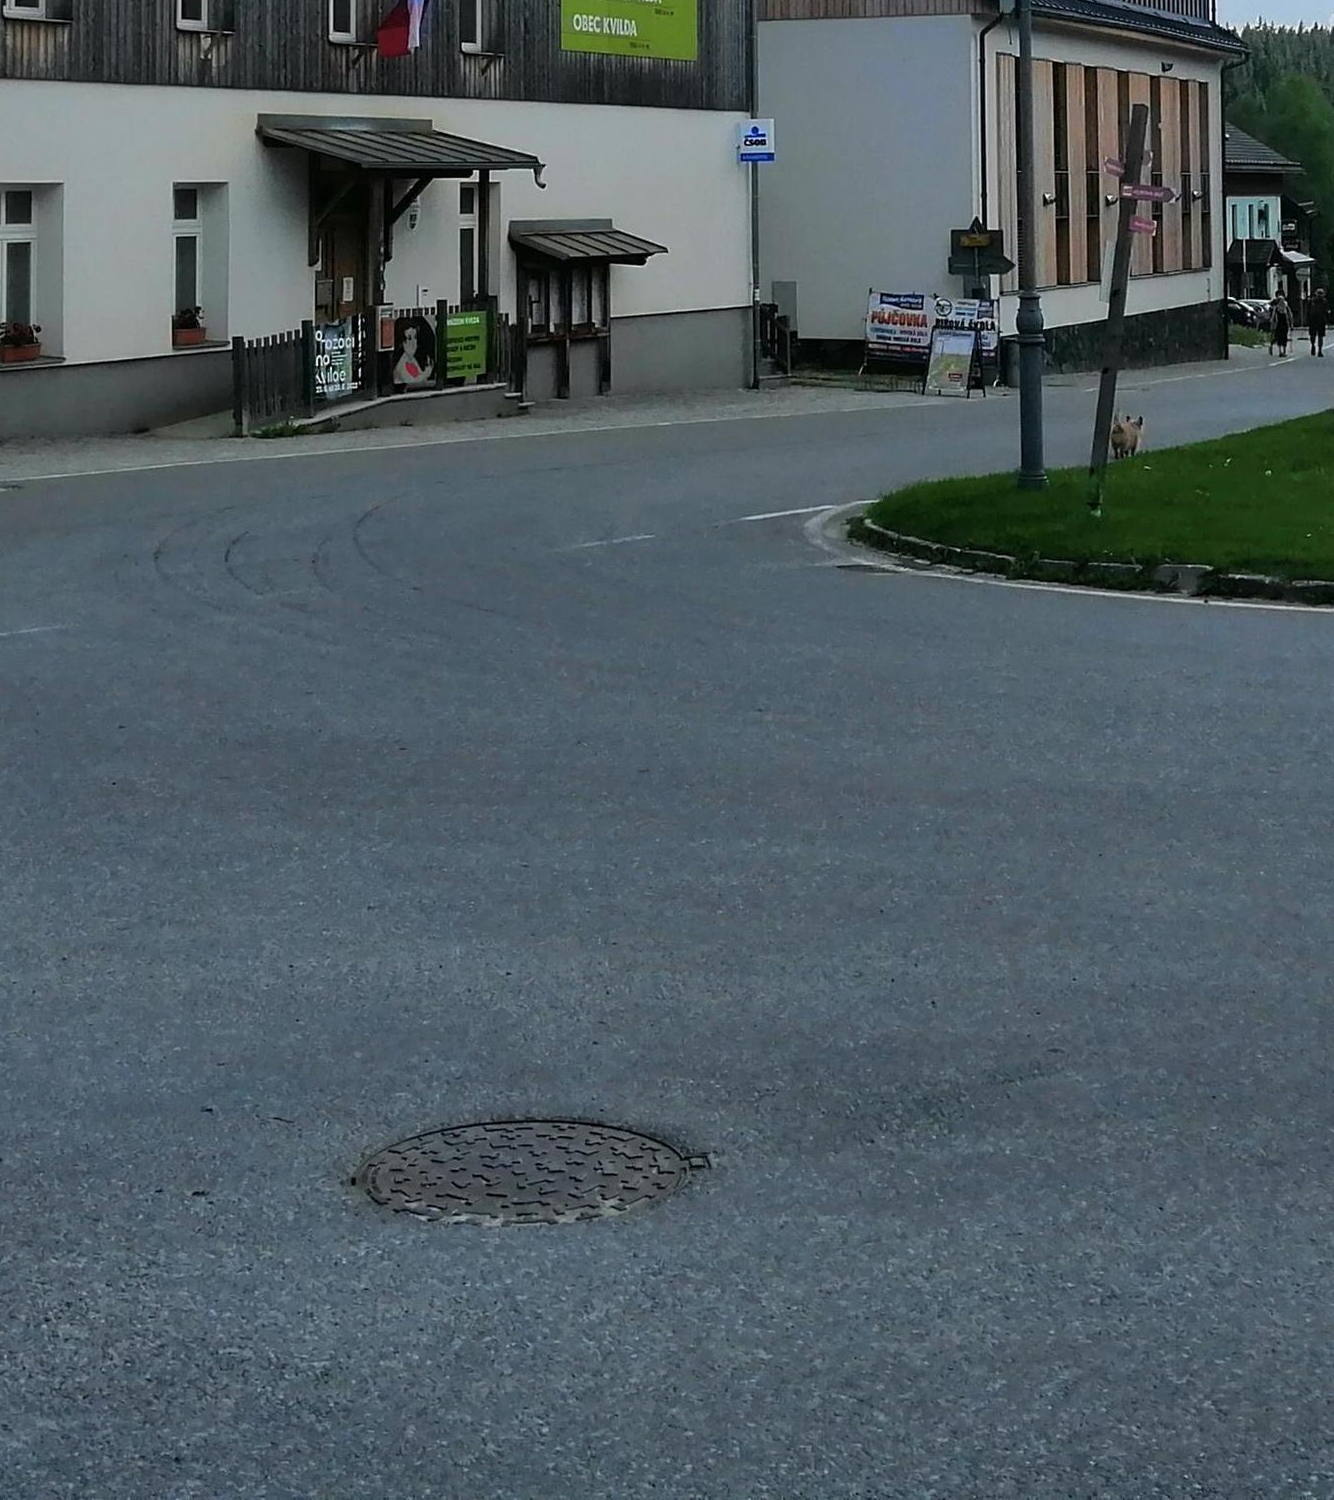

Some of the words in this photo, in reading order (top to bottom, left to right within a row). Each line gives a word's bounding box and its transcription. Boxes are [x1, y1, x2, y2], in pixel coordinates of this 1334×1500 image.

[573, 14, 602, 33] OBEC
[603, 17, 638, 37] KVILDA
[744, 137, 767, 147] ČSOB
